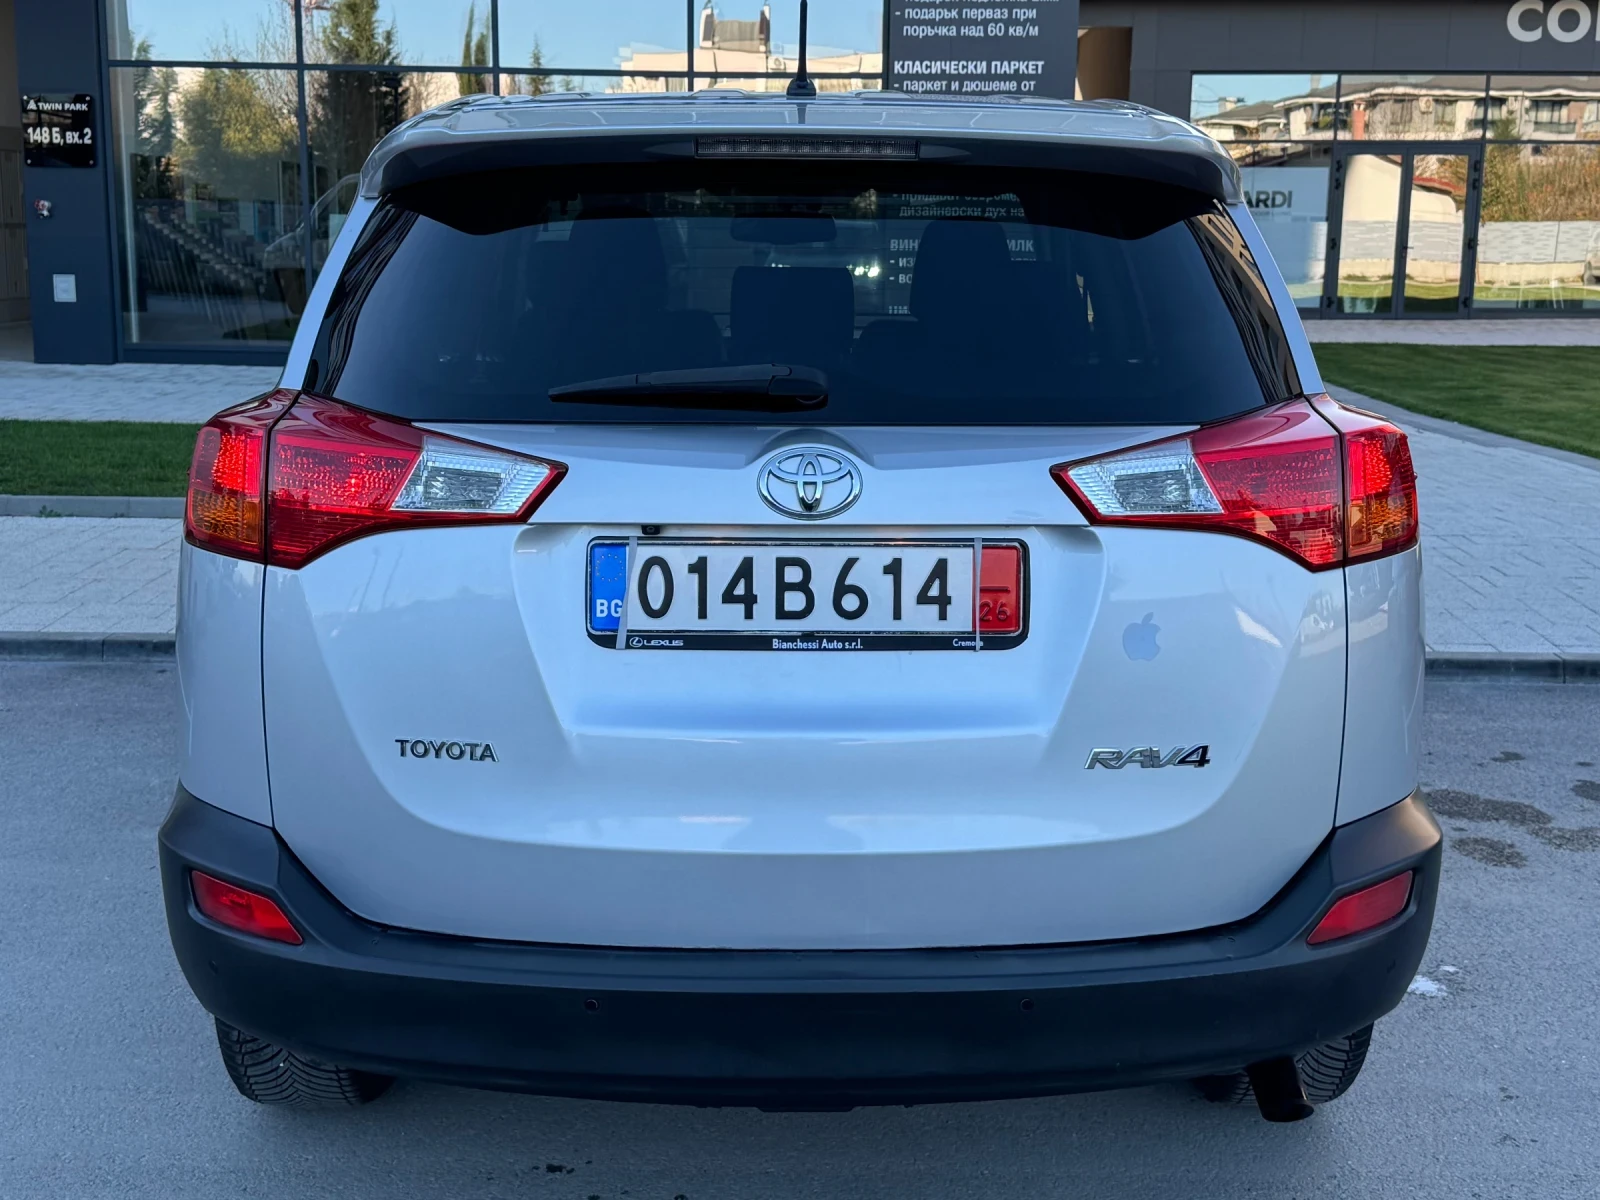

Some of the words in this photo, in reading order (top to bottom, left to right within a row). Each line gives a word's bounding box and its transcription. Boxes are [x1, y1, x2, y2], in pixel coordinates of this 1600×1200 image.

[905, 8, 958, 22] подарък
[963, 8, 1008, 21] перваз
[1012, 8, 1037, 21] при
[903, 25, 956, 39] поръчка
[960, 25, 984, 38] над
[988, 23, 1005, 37] 60
[1008, 24, 1039, 38] кв/м
[894, 61, 987, 74] КЛАСИЧЕСКИ
[991, 61, 1045, 74] ПАРКЕТ
[903, 79, 947, 93] паркет
[951, 80, 959, 91] и
[962, 80, 1017, 93] дюшеме
[1021, 80, 1036, 91] от
[38, 102, 62, 111] TWIN
[64, 103, 88, 111] PARK
[899, 204, 982, 217] дизайнерски
[984, 206, 1007, 219] дух
[1010, 207, 1025, 217] на
[890, 238, 921, 252] ВИН
[637, 555, 952, 620] 014B614
[595, 599, 623, 618] BG
[979, 599, 1011, 621] 26
[772, 638, 819, 649] Bianchessi
[821, 638, 843, 649] Auto
[844, 638, 864, 649] s.r.l.
[952, 638, 984, 647] Cremoa
[394, 738, 500, 762] TOYOTA
[1083, 743, 1211, 770] RAV4
